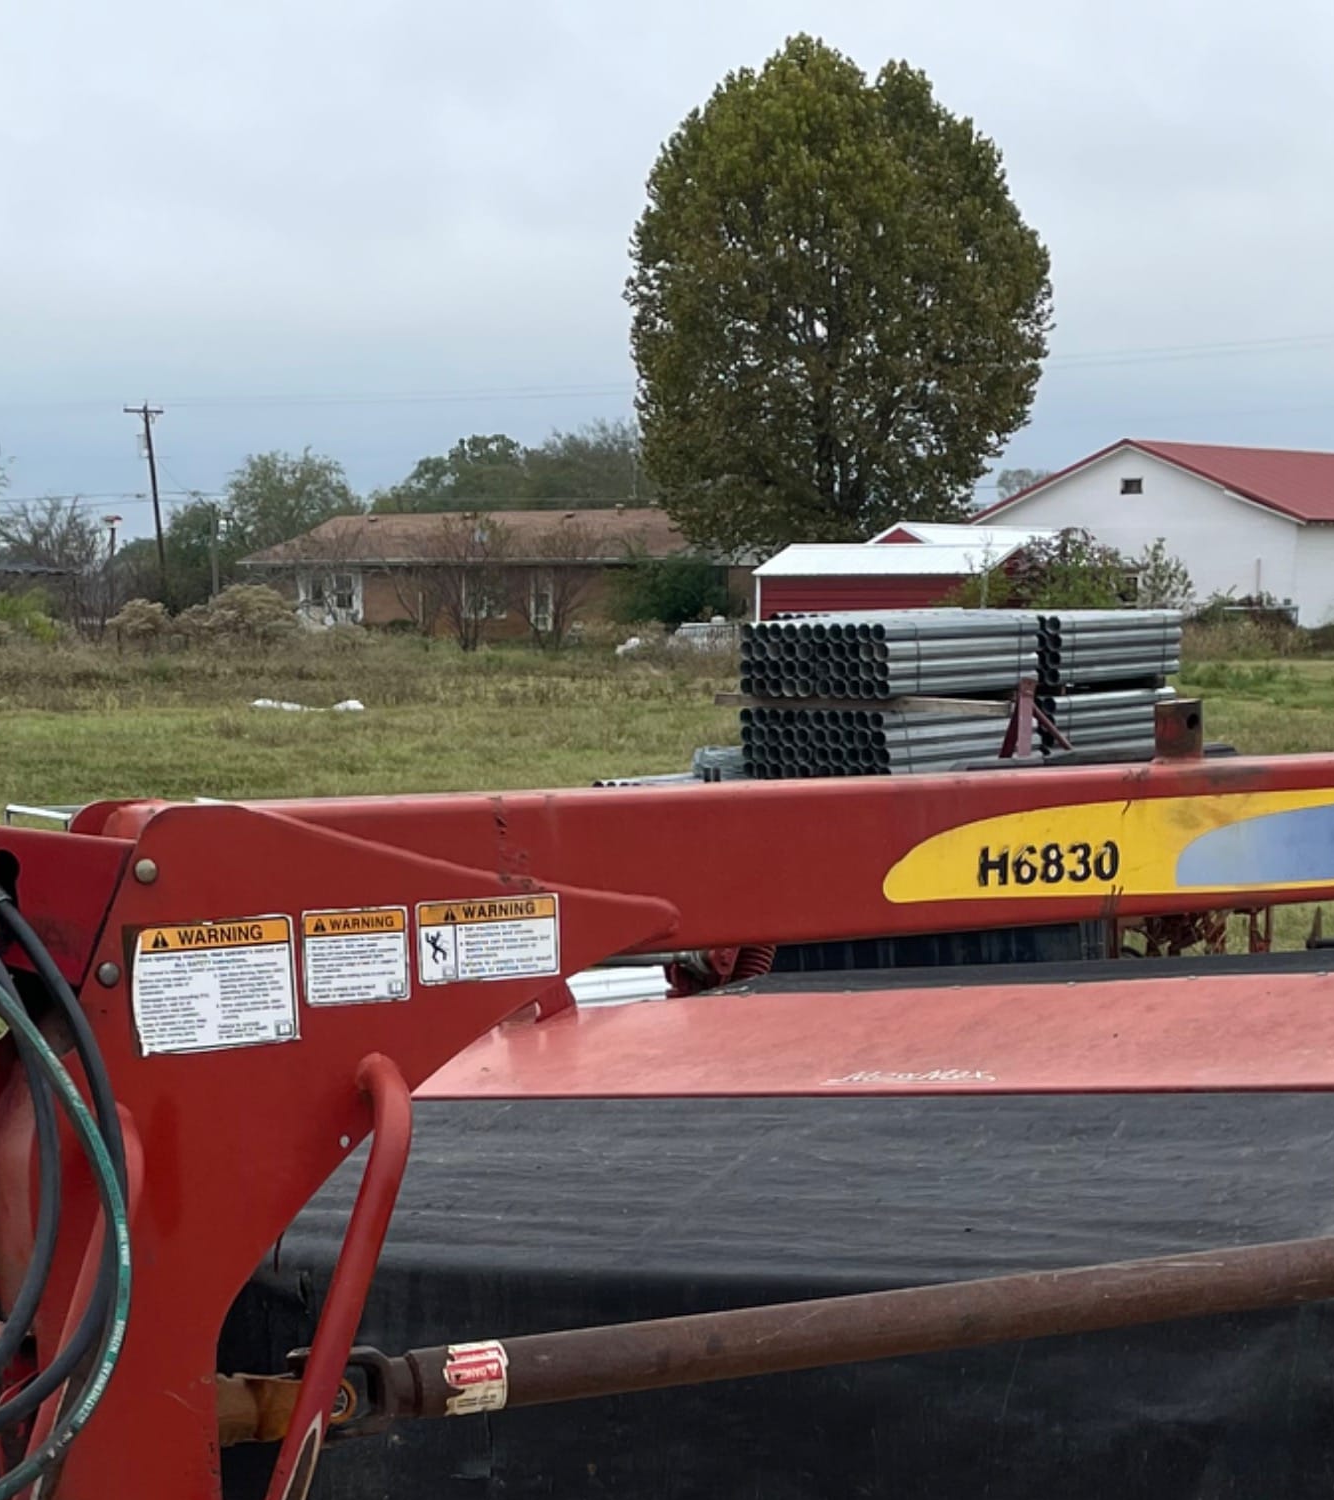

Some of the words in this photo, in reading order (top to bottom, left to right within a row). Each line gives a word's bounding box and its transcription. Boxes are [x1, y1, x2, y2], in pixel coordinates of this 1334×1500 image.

[977, 840, 1120, 887] H6830
[462, 901, 536, 918] WARNING
[329, 916, 394, 931] WARNING
[177, 924, 263, 945] WARNING
